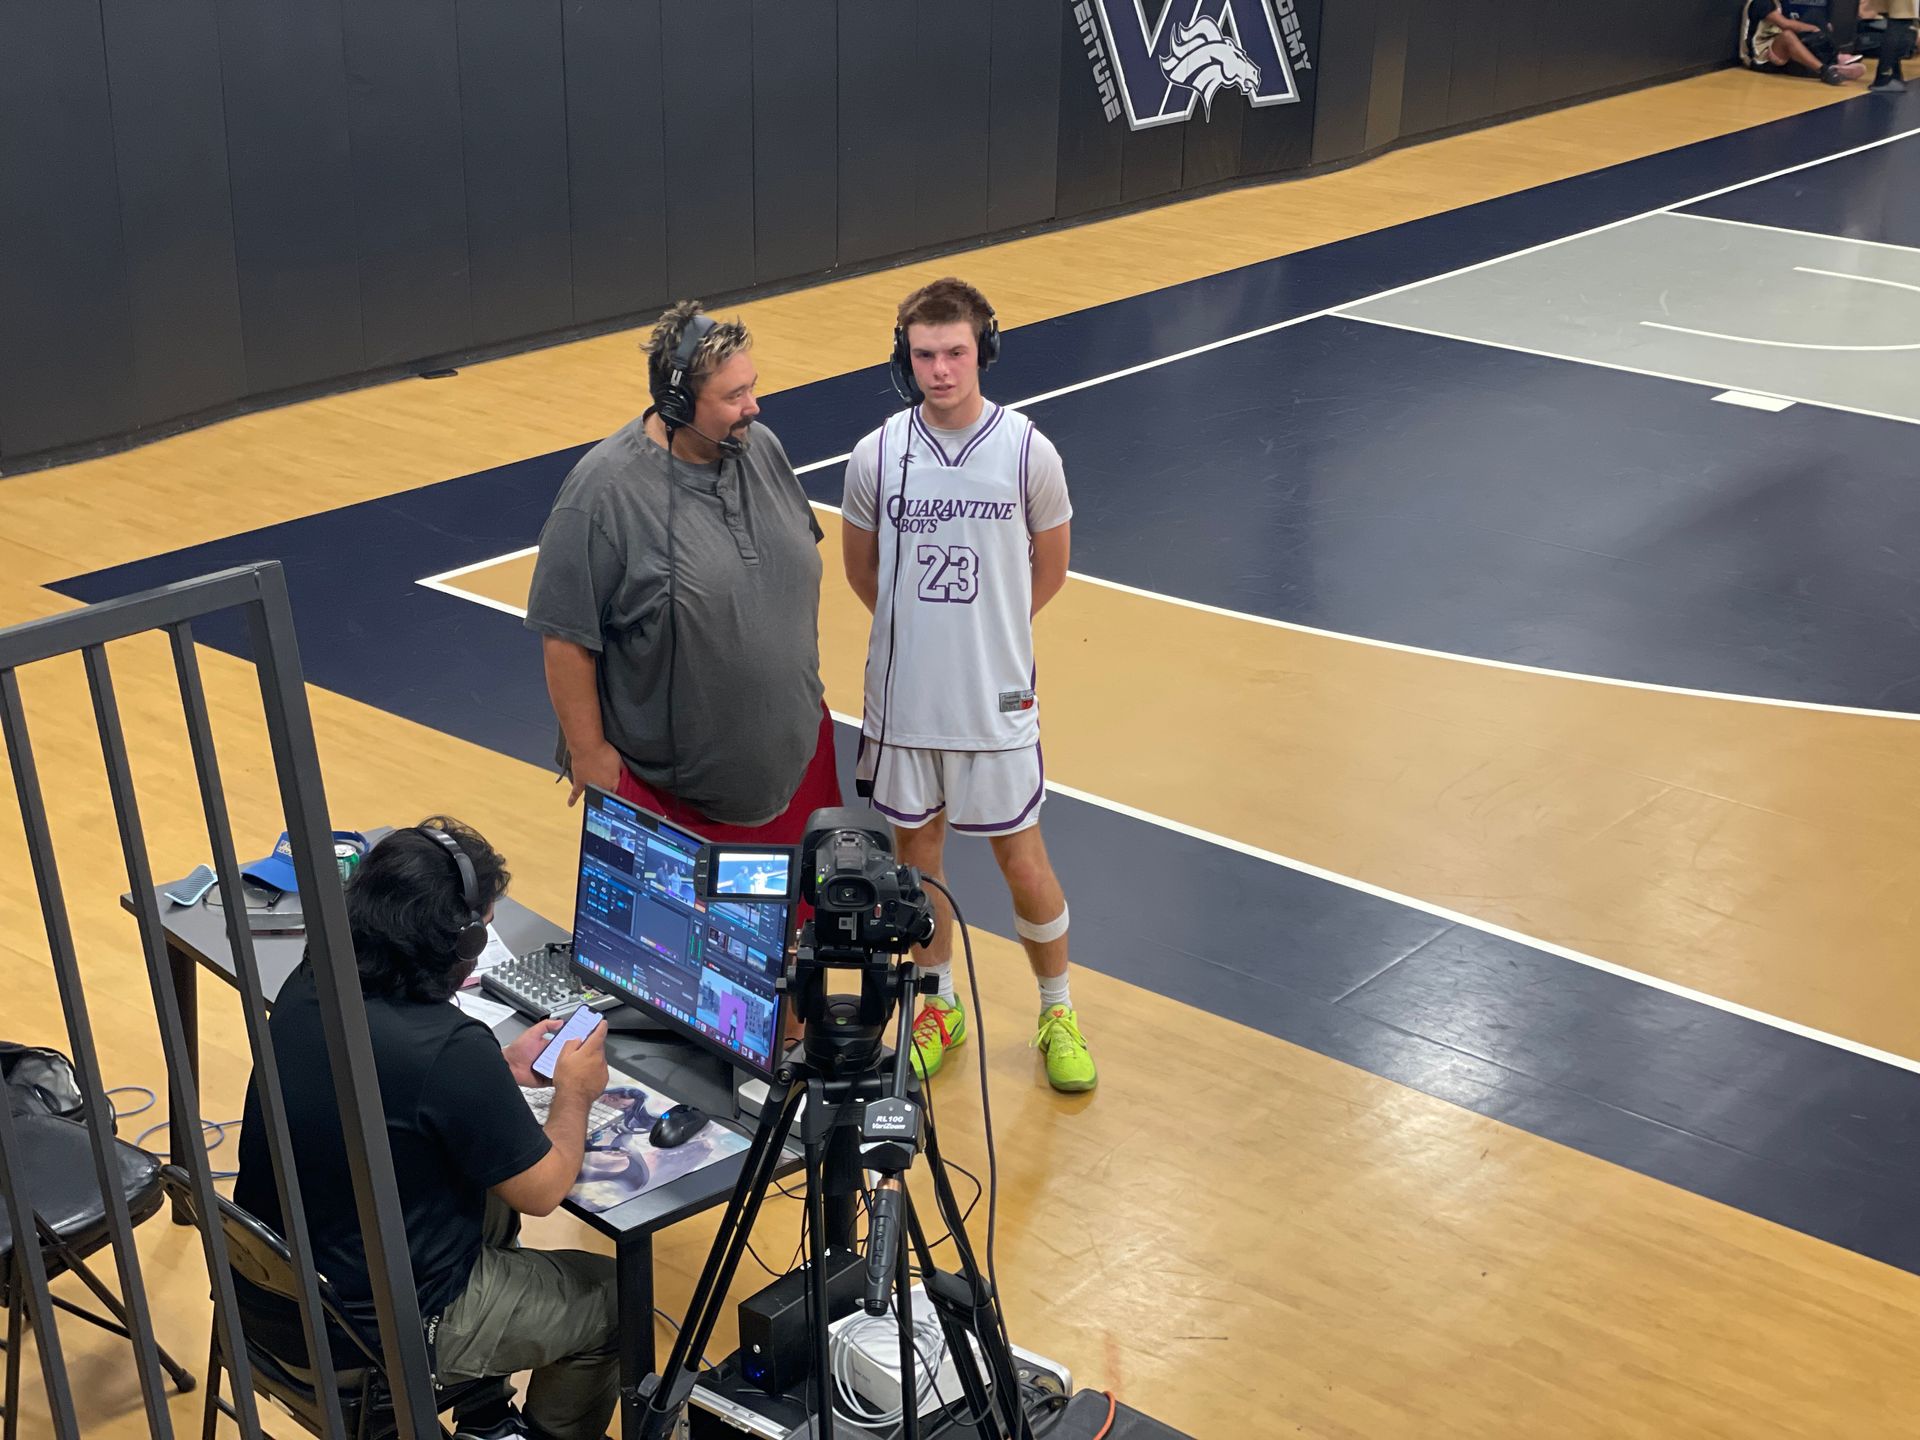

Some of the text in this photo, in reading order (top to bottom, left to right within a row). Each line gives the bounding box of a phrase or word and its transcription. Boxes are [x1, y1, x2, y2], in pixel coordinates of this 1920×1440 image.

[1070, 0, 1121, 122] ENTURE
[900, 518, 937, 533] BOYS
[917, 544, 979, 604] 23
[876, 1115, 904, 1123] RL100
[428, 1322, 436, 1344] Adobe
